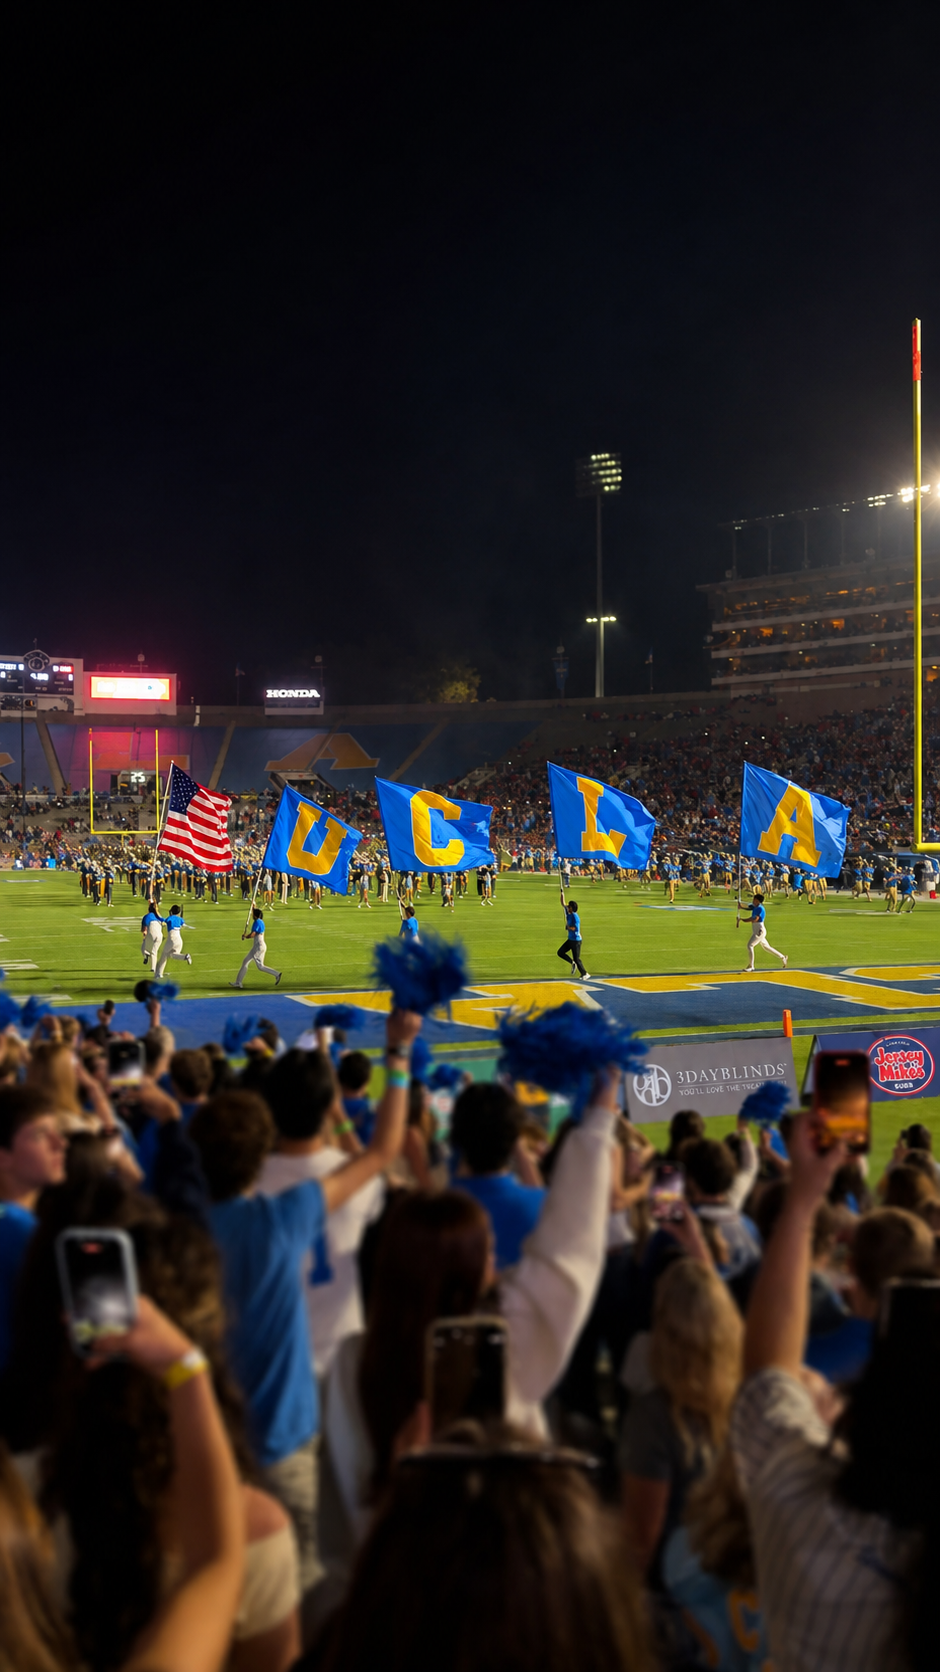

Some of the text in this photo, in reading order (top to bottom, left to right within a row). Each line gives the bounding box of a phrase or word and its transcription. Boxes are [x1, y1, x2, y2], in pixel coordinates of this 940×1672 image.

[266, 689, 321, 698] HONDA
[287, 800, 348, 876] U
[410, 790, 465, 867] C
[576, 776, 628, 859] L
[757, 780, 822, 868] A
[726, 1084, 741, 1092] THE
[874, 1046, 925, 1068] Jersey
